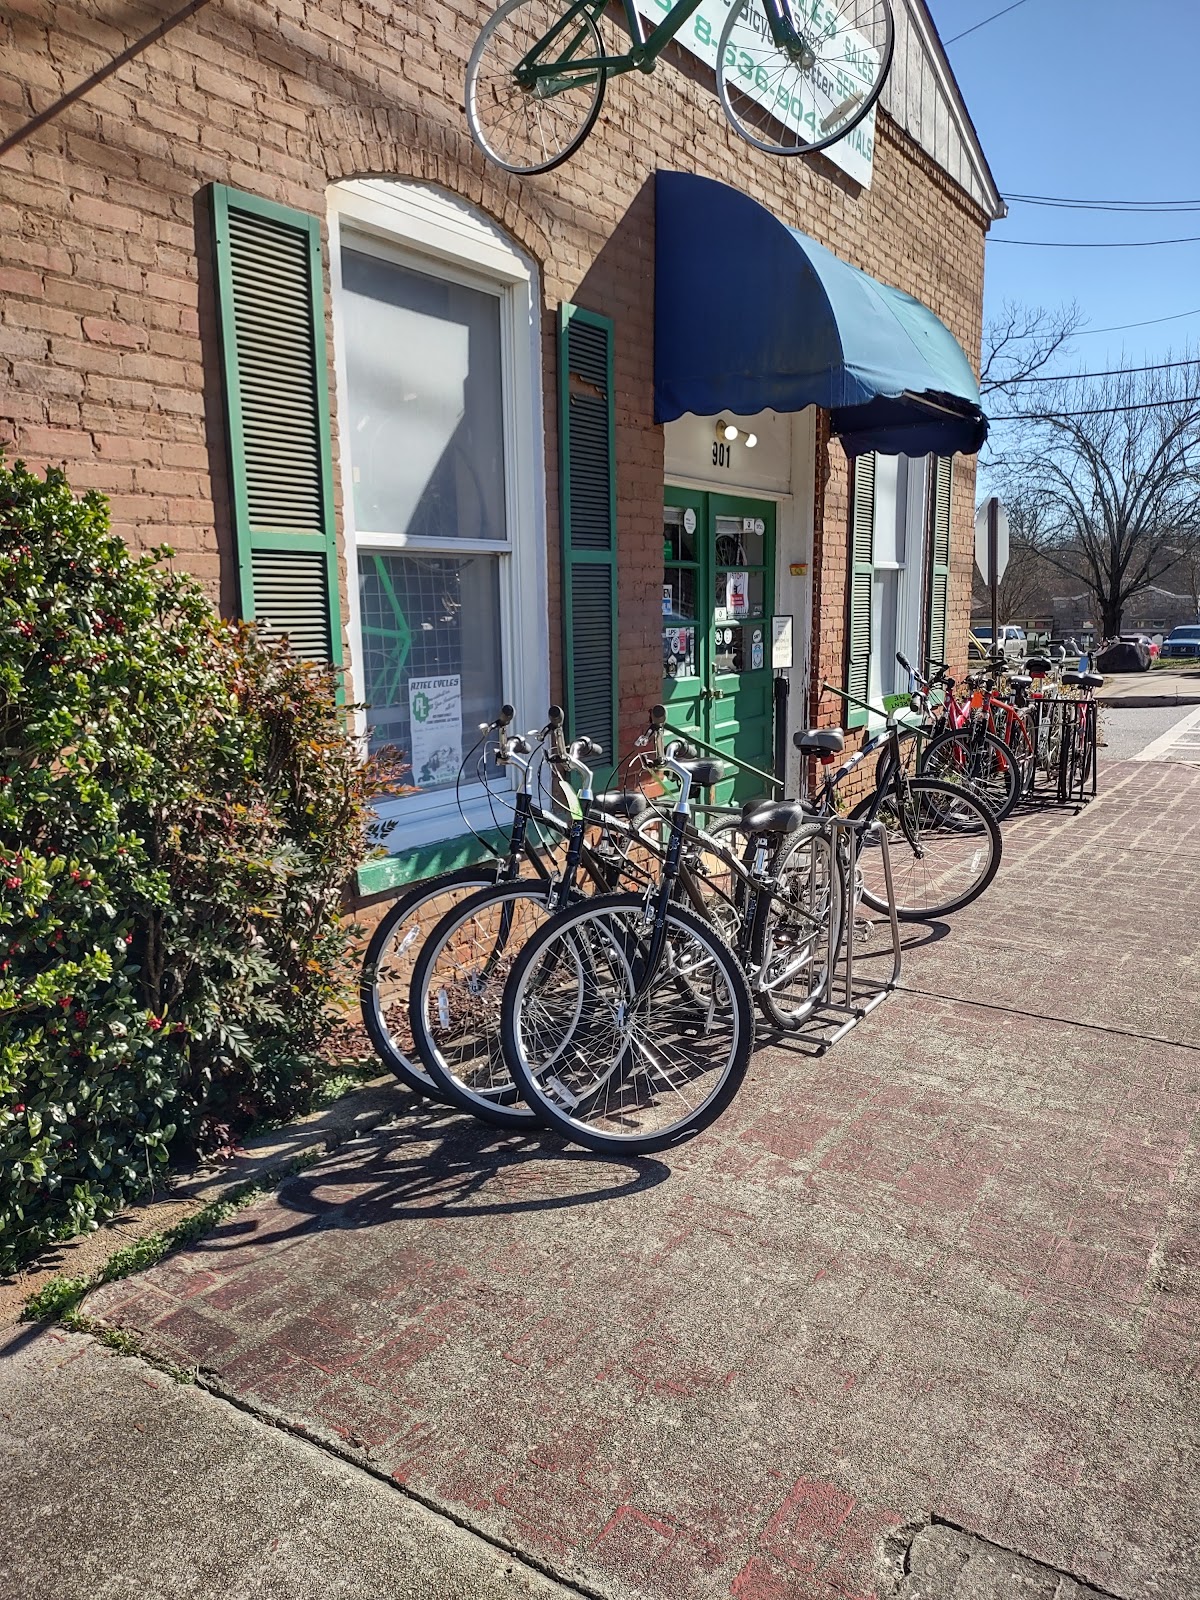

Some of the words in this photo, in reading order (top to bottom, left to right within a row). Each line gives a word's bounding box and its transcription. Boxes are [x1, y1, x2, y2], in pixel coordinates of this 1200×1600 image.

[845, 35, 874, 84] SALES
[712, 441, 730, 468] 901
[411, 681, 432, 691] AZTEC
[433, 678, 459, 688] CYCLES
